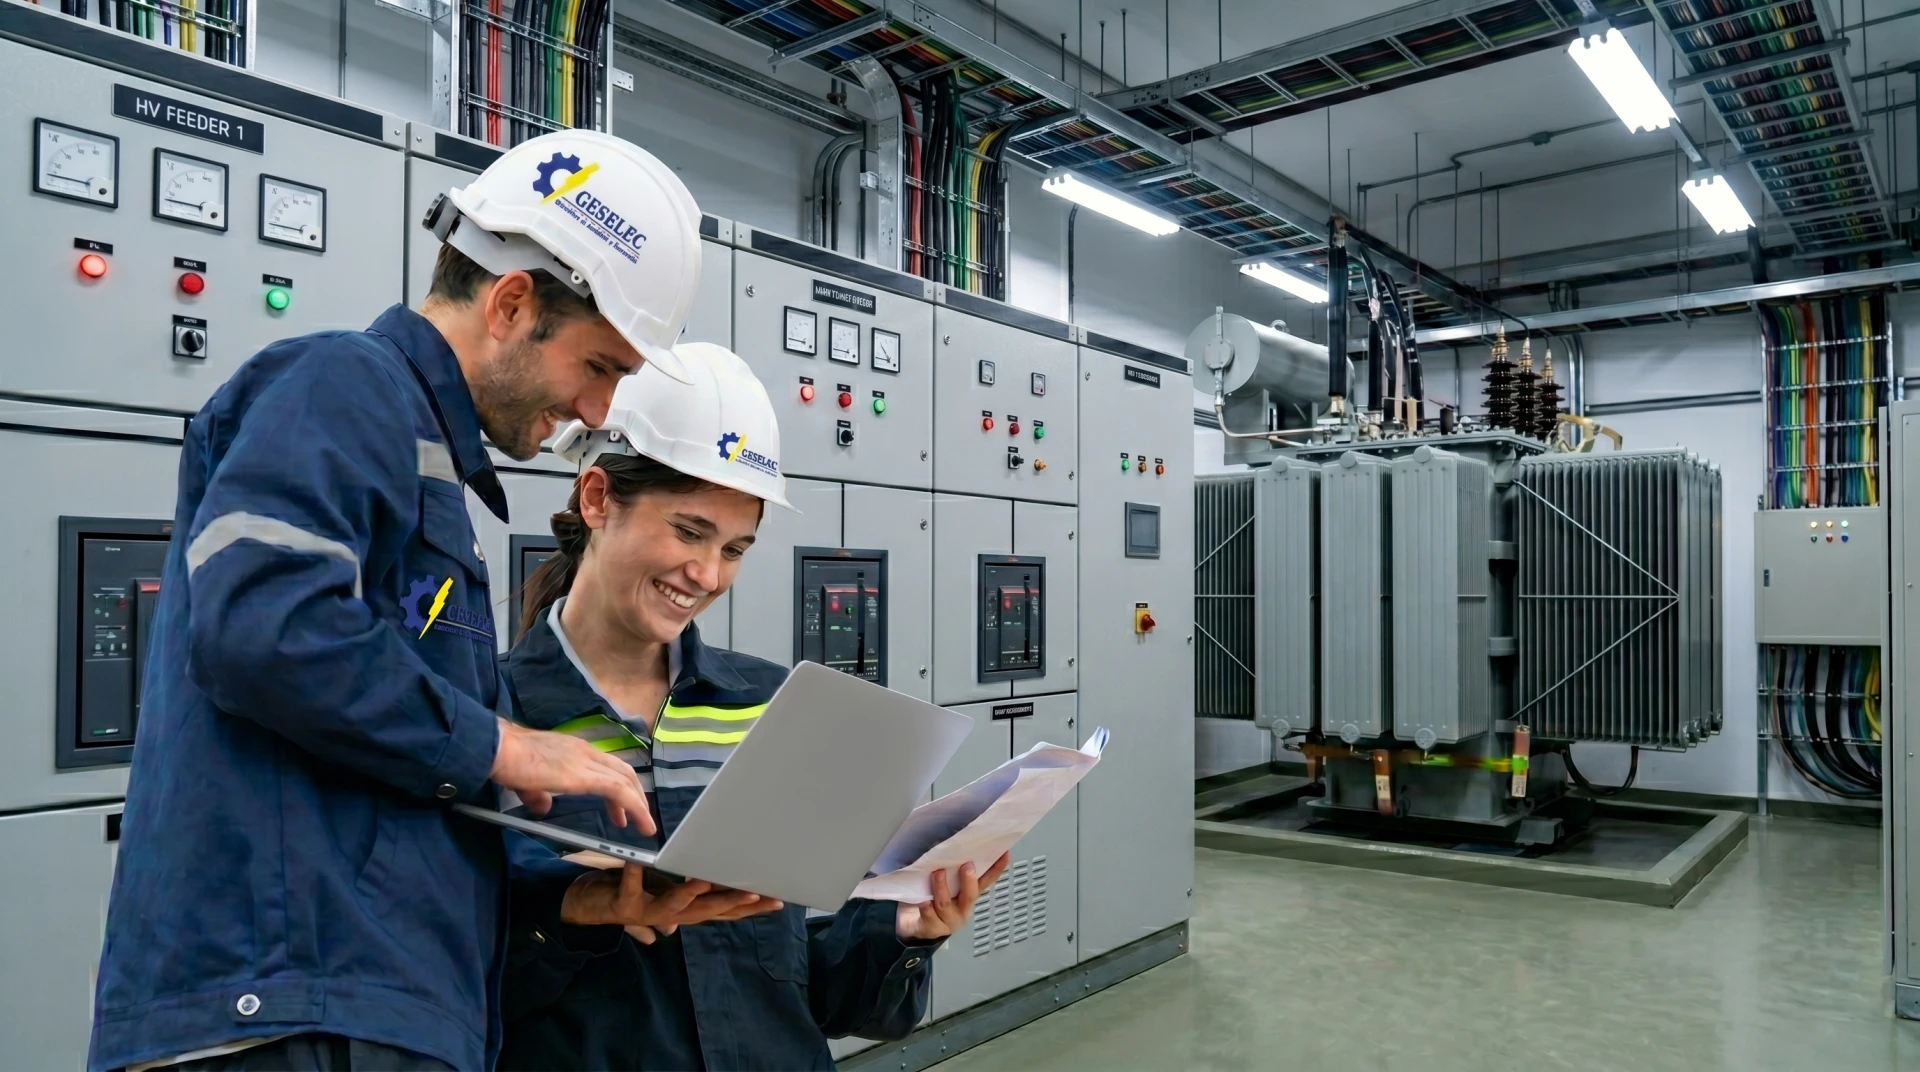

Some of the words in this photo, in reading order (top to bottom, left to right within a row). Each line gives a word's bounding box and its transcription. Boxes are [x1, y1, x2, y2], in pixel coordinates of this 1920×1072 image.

[136, 97, 161, 118] HV
[166, 105, 230, 138] FEEDER
[236, 125, 243, 141] 1
[575, 190, 647, 250] GESELEC
